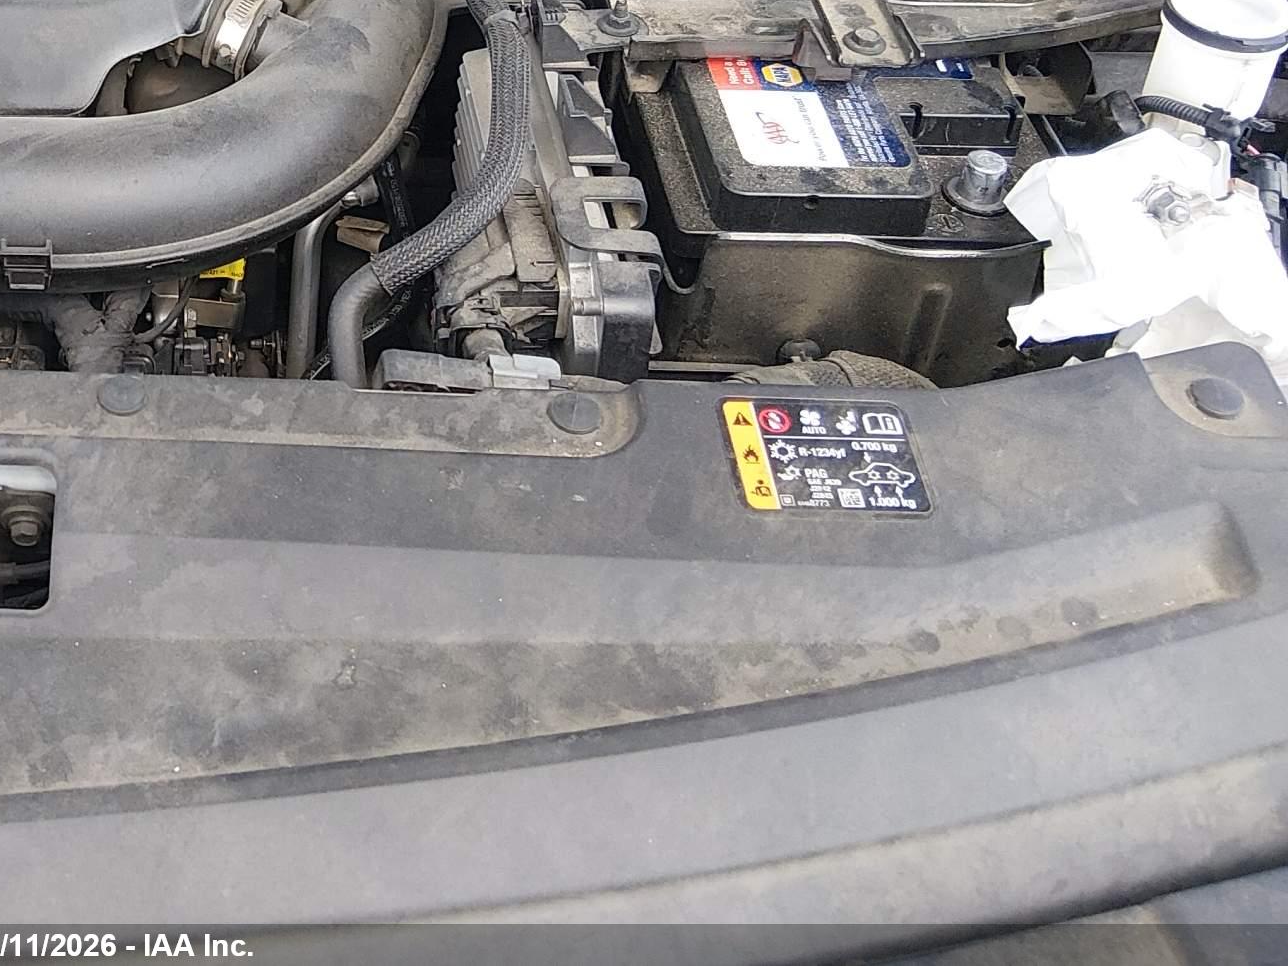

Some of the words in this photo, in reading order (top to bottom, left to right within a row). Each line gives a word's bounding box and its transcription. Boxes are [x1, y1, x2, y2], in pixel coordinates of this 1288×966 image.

[724, 67, 739, 85] Need
[772, 66, 792, 83] NAPA
[793, 96, 808, 113] trust
[802, 114, 812, 125] can
[808, 126, 820, 139] you
[815, 141, 829, 162] Power
[801, 426, 827, 435] AUTO
[851, 441, 880, 452] 0.700
[882, 442, 898, 453] kg
[804, 468, 828, 479] PAG
[868, 497, 900, 508] 1.000
[901, 497, 917, 509] kg
